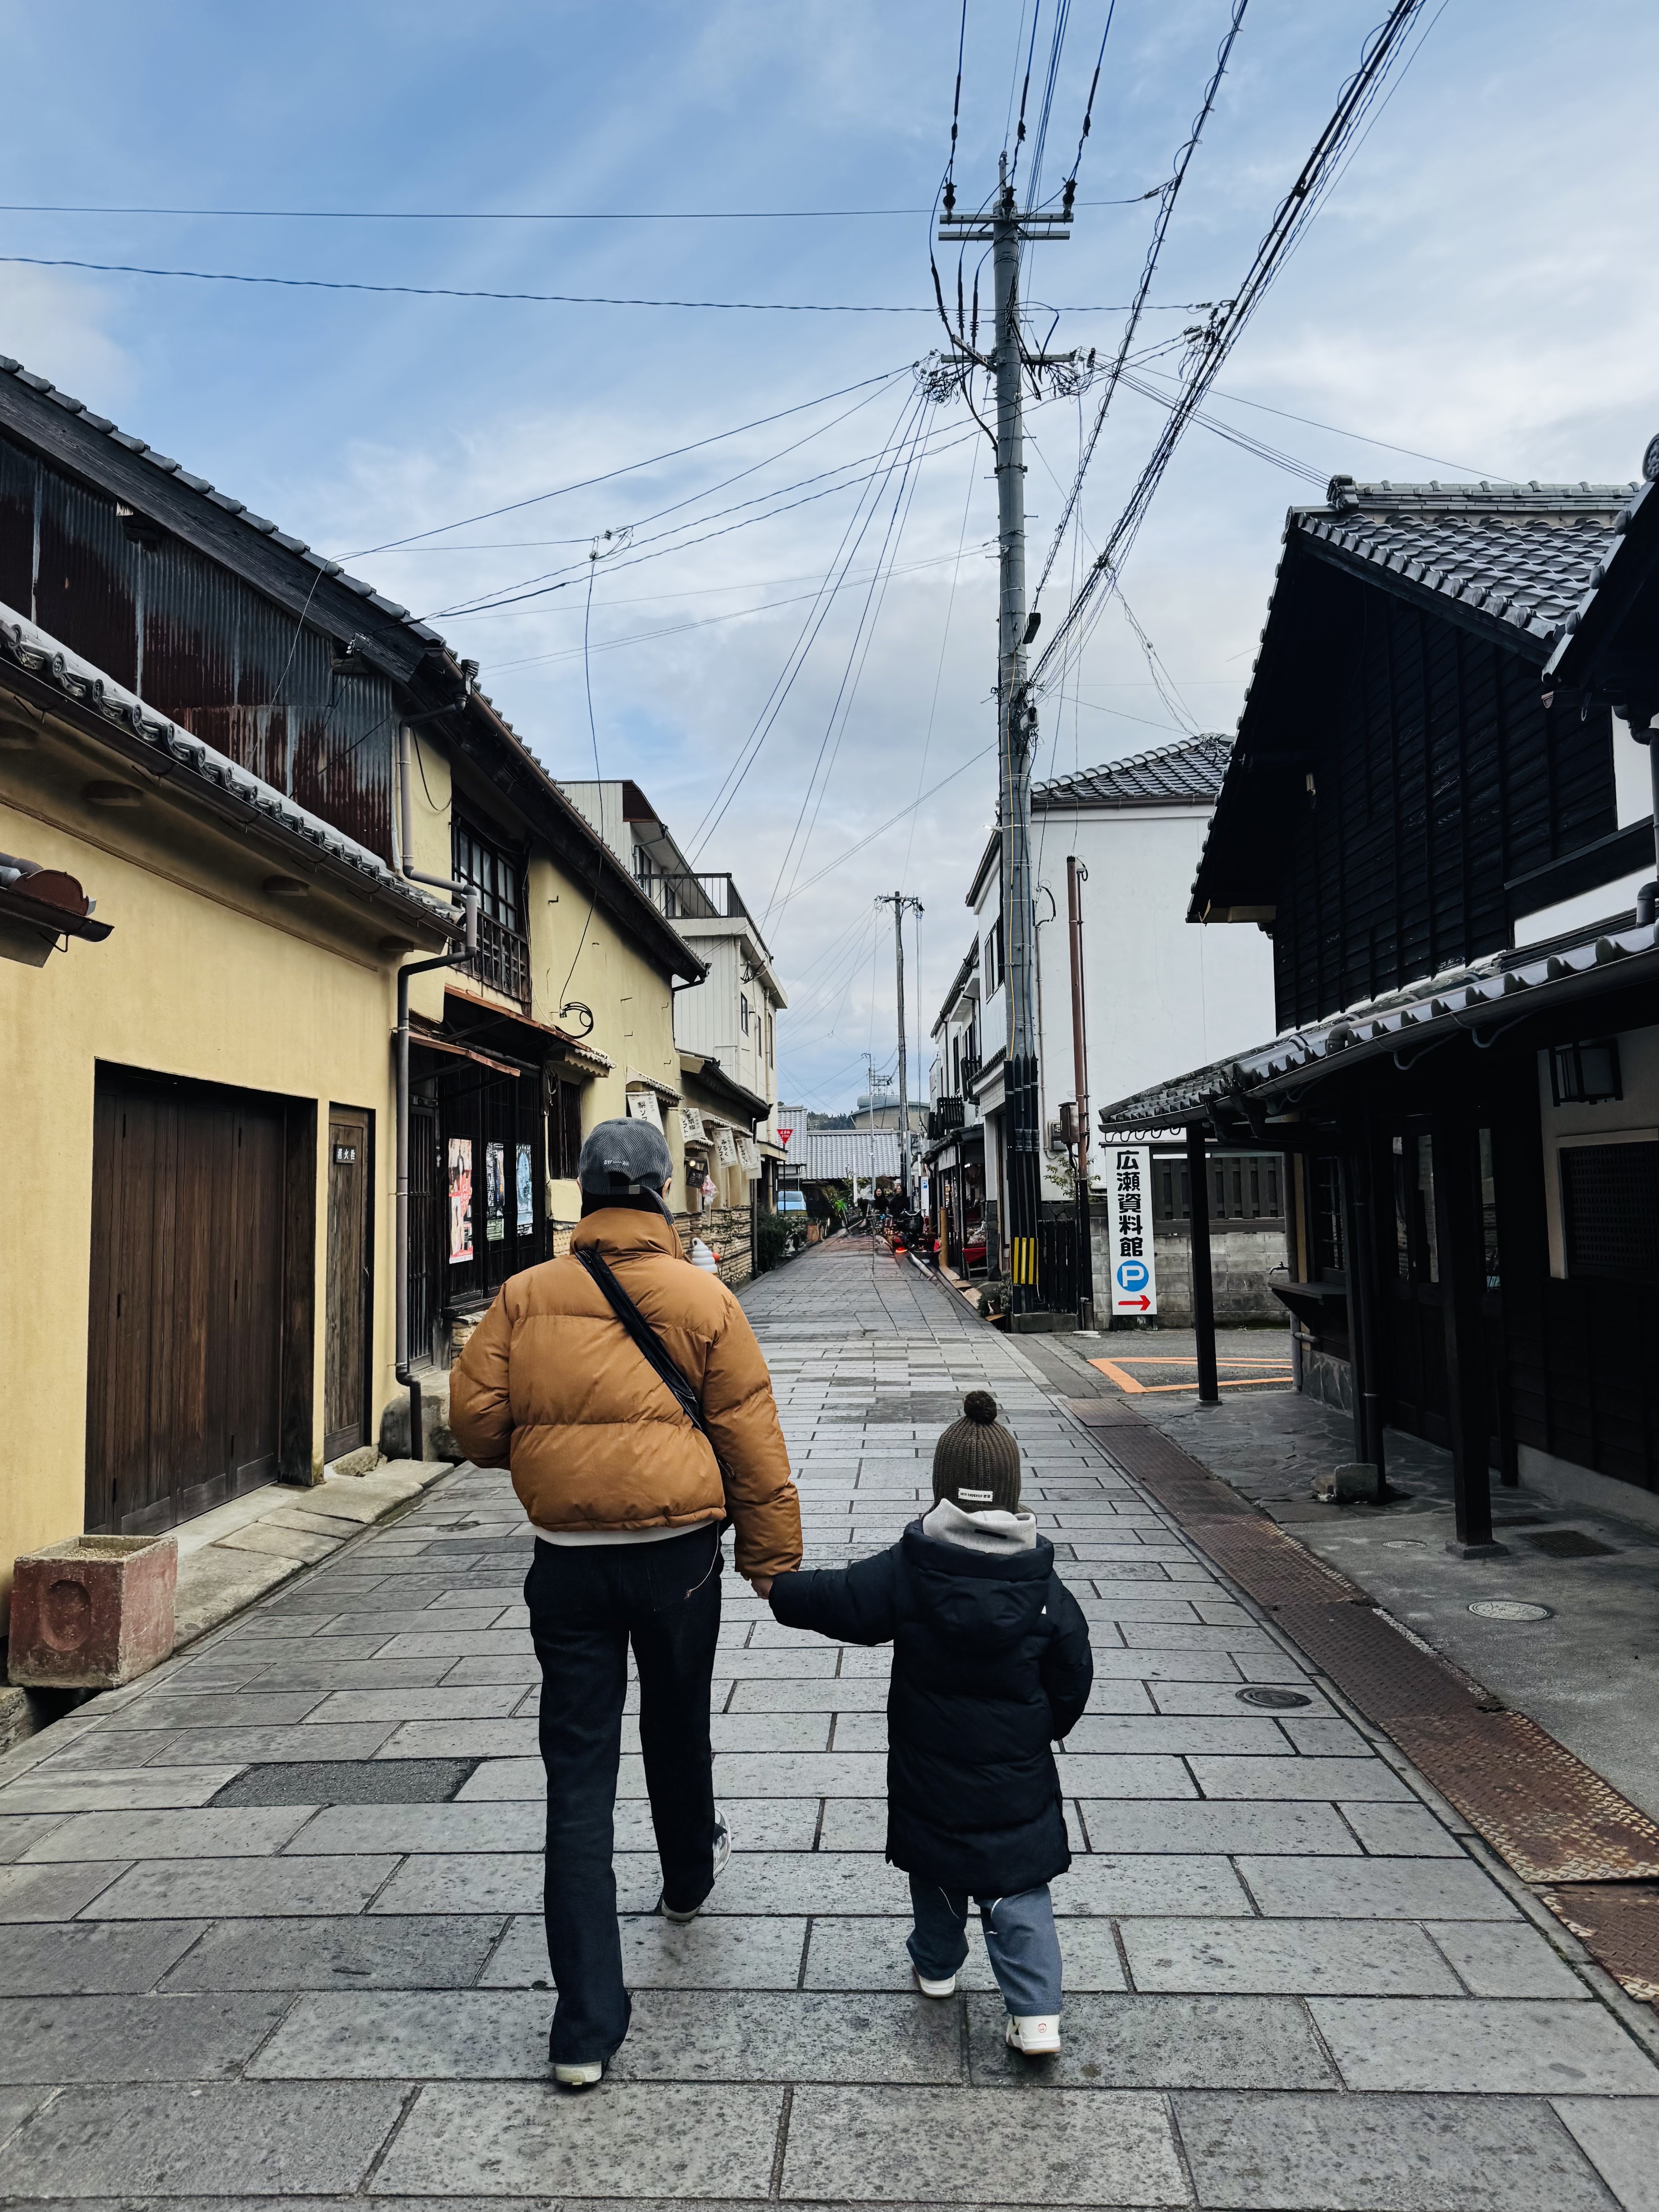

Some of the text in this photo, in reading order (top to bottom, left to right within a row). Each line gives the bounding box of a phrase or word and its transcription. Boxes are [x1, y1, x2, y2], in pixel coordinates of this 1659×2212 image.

[338, 1148, 355, 1160] 消火栓
[1117, 1150, 1143, 1257] 広瀬資料館
[1122, 1265, 1144, 1287] P
